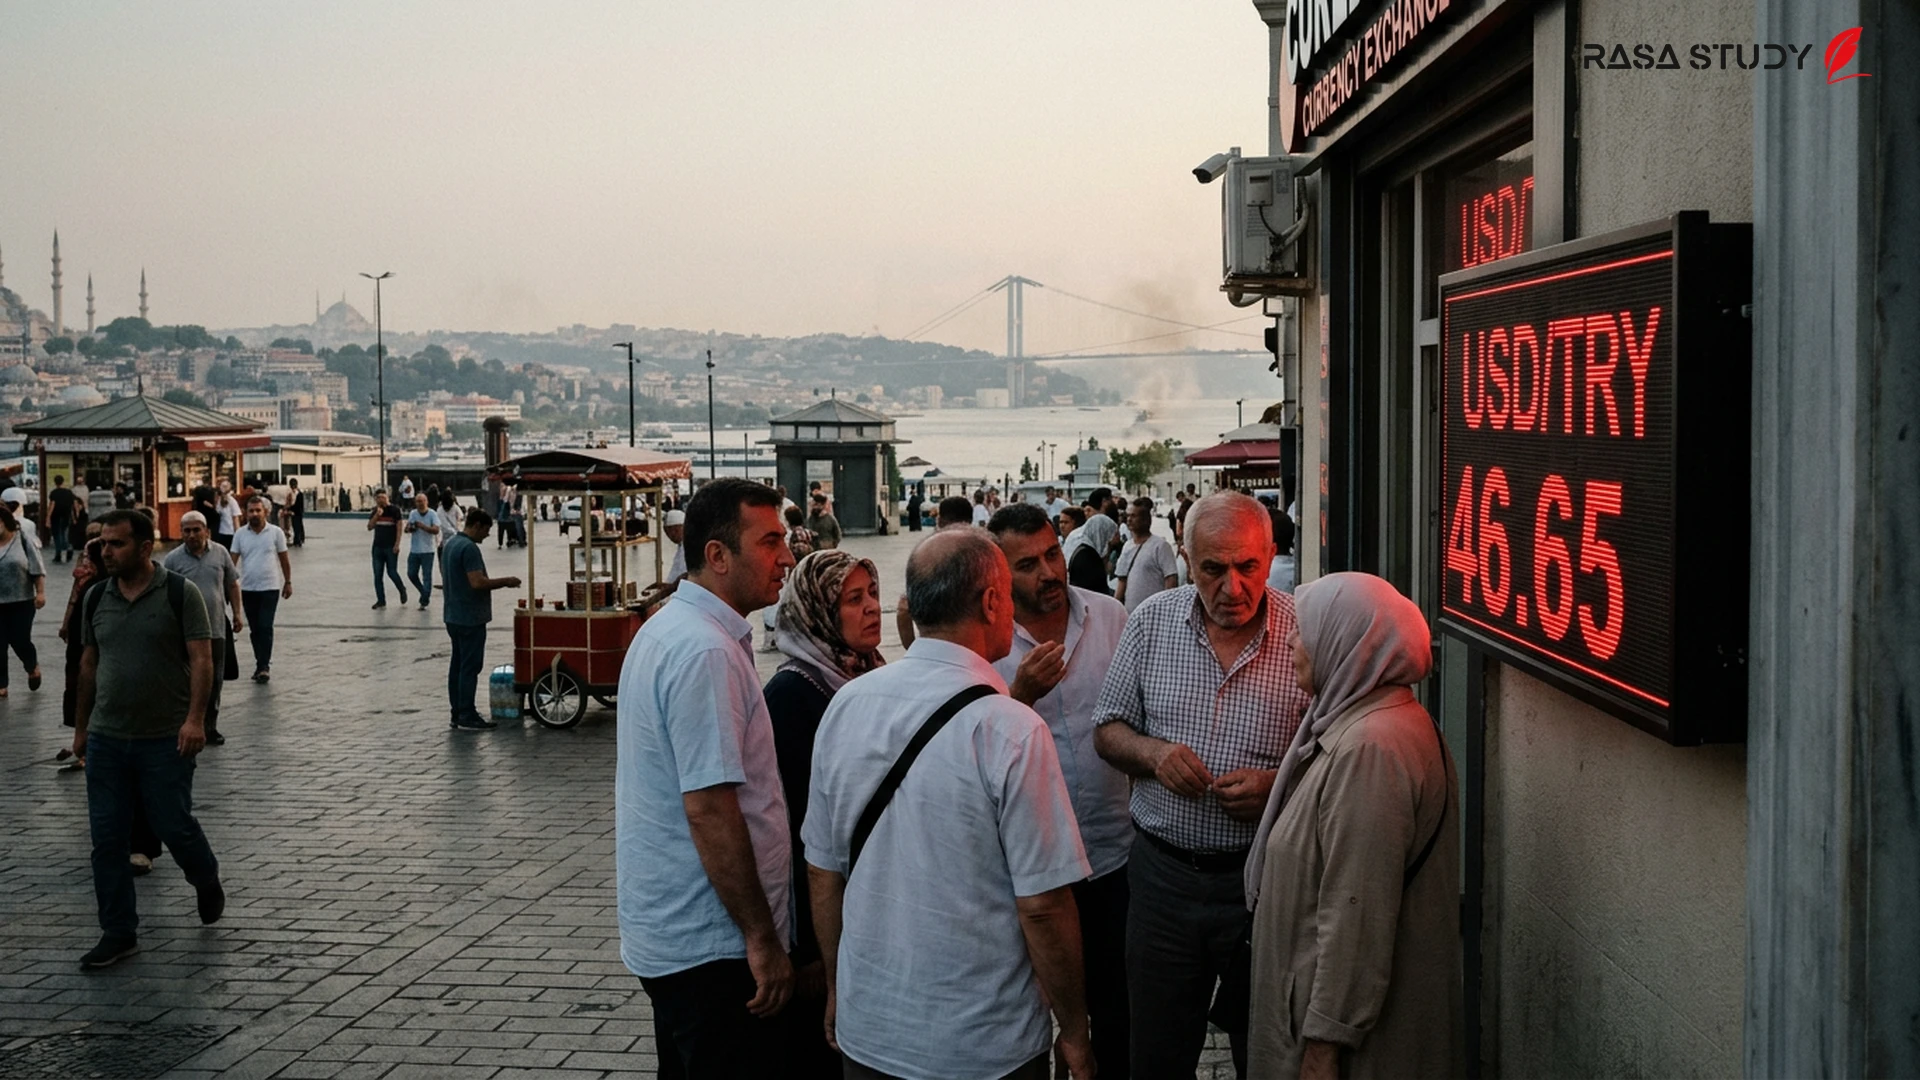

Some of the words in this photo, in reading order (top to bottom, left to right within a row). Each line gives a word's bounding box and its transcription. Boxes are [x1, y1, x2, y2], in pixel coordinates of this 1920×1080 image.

[1302, 40, 1360, 137] CURRENCY
[1364, 0, 1450, 82] EXCHAN
[1463, 307, 1661, 438] USD/TRY
[1447, 465, 1624, 660] 46.65
